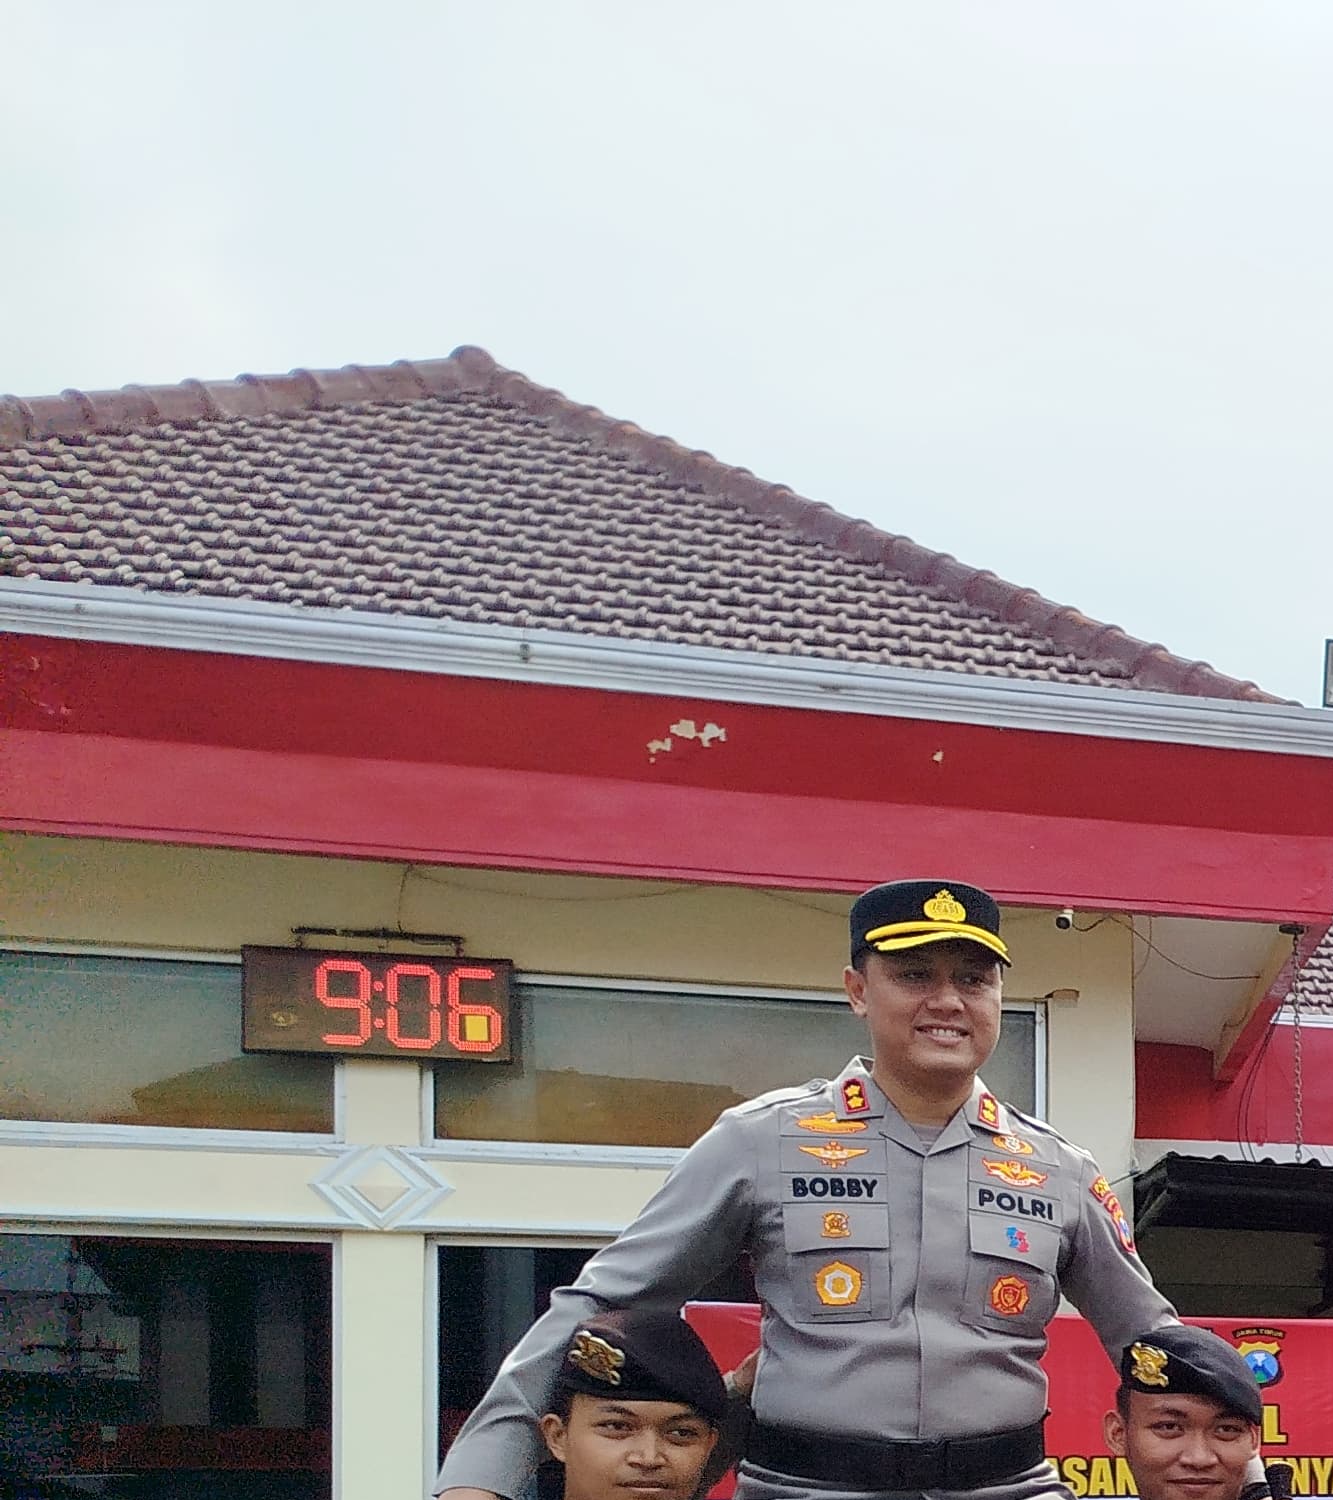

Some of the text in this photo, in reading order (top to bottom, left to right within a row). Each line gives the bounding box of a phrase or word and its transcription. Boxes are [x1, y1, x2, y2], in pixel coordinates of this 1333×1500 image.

[315, 959, 501, 1052] 9:06
[792, 1177, 878, 1198] BOBBY
[978, 1188, 1054, 1220] POLRI
